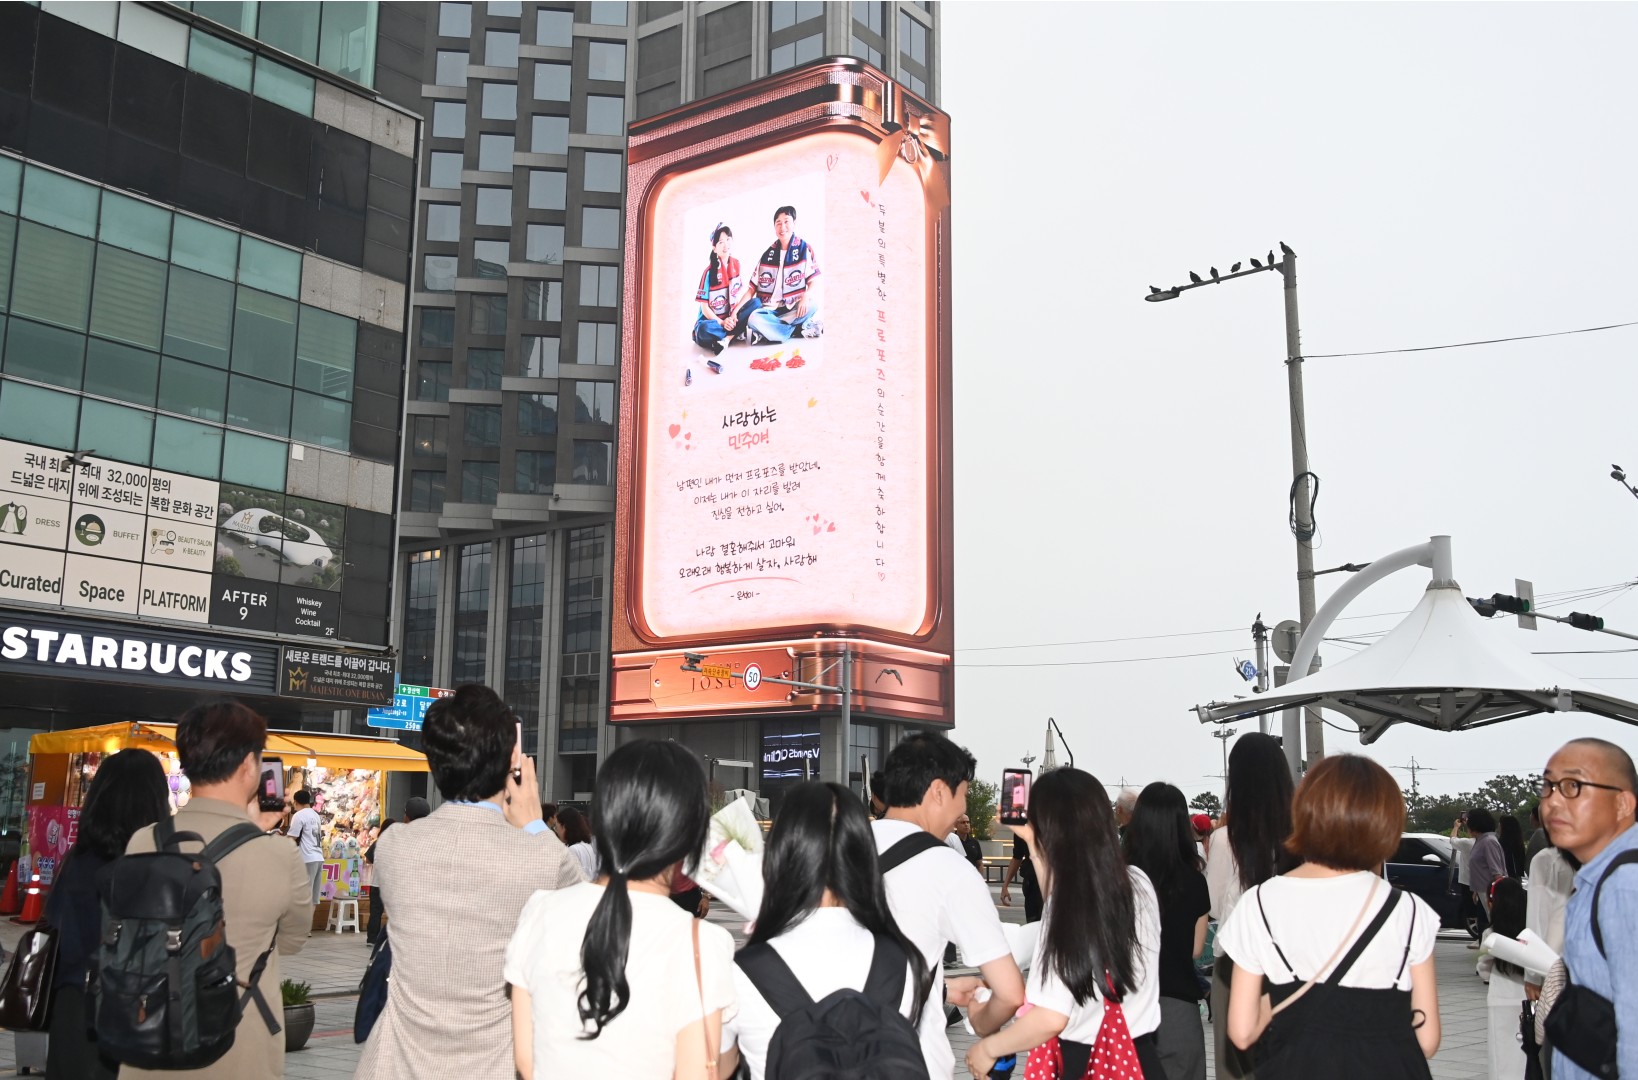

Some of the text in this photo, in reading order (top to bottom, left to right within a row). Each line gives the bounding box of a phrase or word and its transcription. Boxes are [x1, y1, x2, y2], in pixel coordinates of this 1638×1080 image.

[722, 406, 776, 429] 사랑하는
[24, 452, 46, 470] 국내
[80, 464, 102, 480] 최대
[107, 469, 148, 488] 32,000
[152, 478, 172, 494] 평의
[676, 478, 702, 491] 남편인
[705, 476, 722, 486] 내가
[726, 472, 743, 484] 먼저
[746, 462, 786, 480] 프로포즈를
[10, 471, 214, 520] 드넓은 대지 위에 조성되는 복합 문화 공간
[694, 480, 800, 504] 이제는 내가 이 자리를 빌려
[712, 506, 732, 520] 진심을
[736, 504, 762, 517] 전하고
[36, 518, 60, 528] DRESS
[112, 530, 140, 541] BUFFET
[178, 536, 213, 548] BEAUTY SALON
[182, 548, 206, 557] K-BEAUTY
[696, 536, 796, 556] 나랑 결혼해줘서 고마워
[680, 566, 712, 578] 오래오래
[715, 561, 752, 575] 행복하게
[784, 553, 818, 566] 사랑해
[0, 570, 62, 594] Curated
[79, 580, 125, 602] Space
[222, 589, 268, 606] AFTER
[143, 588, 207, 612] PLATFORM
[296, 596, 322, 608] Whiskey
[239, 606, 248, 620] 9
[300, 608, 316, 616] Wine
[296, 618, 320, 628] Cocktail
[326, 628, 334, 636] 2F
[1, 626, 252, 682] STARBUCKS
[286, 650, 310, 664] 새로운
[311, 653, 342, 668] 트렌드를
[344, 656, 366, 670] 이끌어
[692, 676, 745, 692] JOSU
[748, 672, 758, 683] 50
